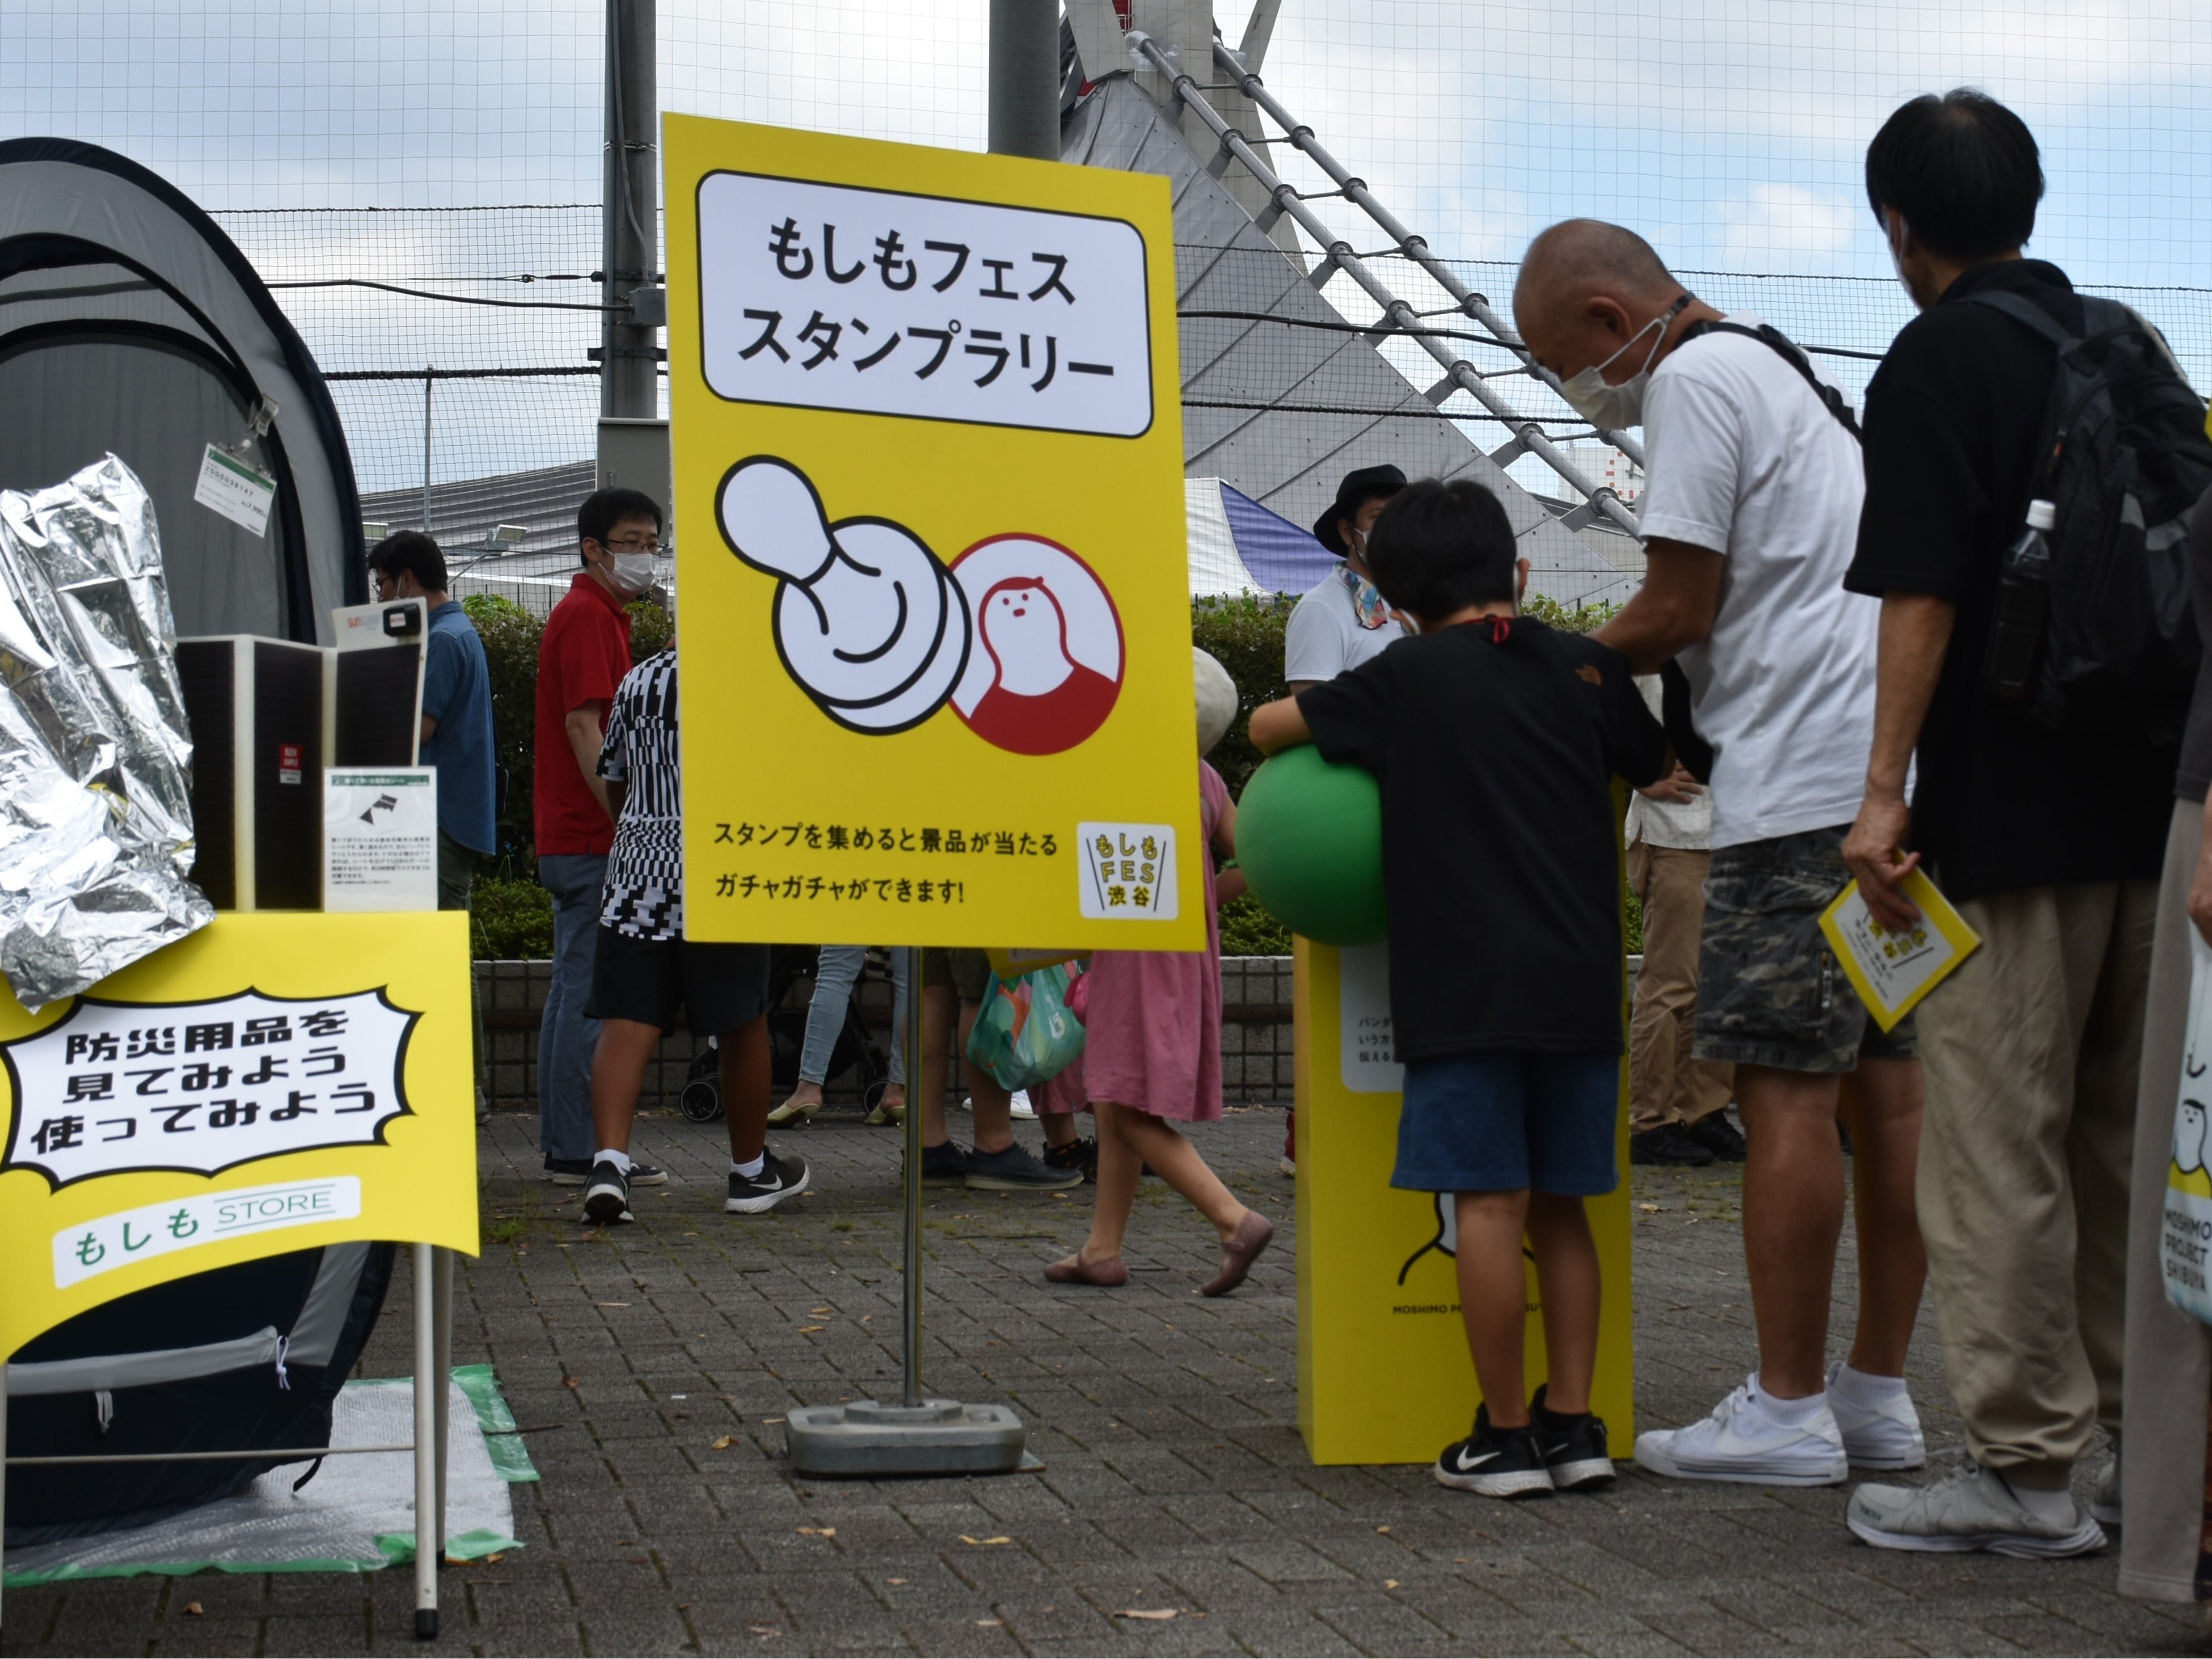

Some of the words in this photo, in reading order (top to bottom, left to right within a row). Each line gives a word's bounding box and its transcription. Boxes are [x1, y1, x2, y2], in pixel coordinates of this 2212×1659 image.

[769, 217, 1075, 305] もしもフェス
[738, 309, 1114, 392] スタンプラリー
[715, 822, 1057, 856] スタンプを集めると景品が当たる
[1096, 833, 1157, 860] もしも
[1100, 860, 1154, 884] FES
[1108, 885, 1150, 907] 渋谷
[66, 1010, 349, 1065] 防災用品を
[1359, 1051, 1394, 1062] 伝える
[63, 1046, 345, 1104] 見てみよう
[31, 1083, 375, 1155] 使ってみよう
[75, 1209, 199, 1267] もしも
[218, 1192, 332, 1224] STORE
[1392, 1305, 1448, 1315] MOSHIMO
